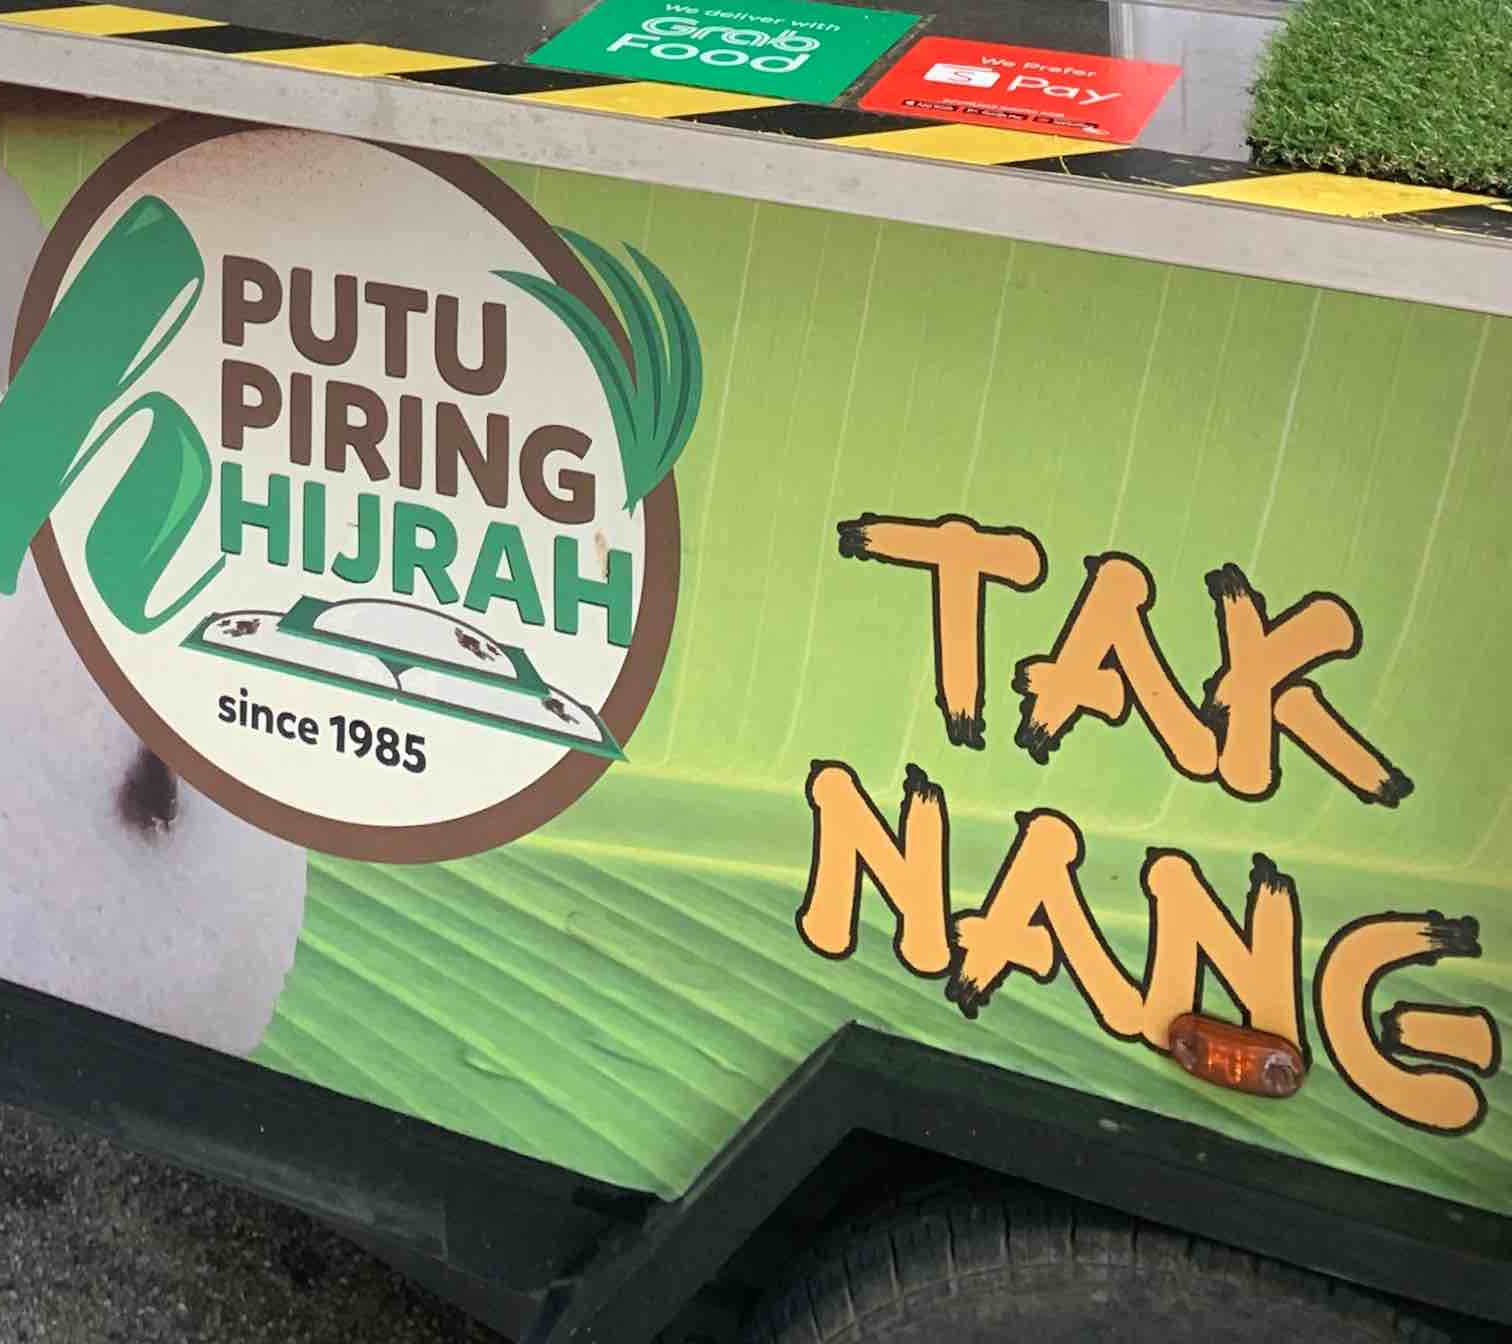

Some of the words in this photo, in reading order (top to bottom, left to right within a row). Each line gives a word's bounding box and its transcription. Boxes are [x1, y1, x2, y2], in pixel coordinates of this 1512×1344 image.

[605, 32, 811, 73] Food
[641, 15, 821, 53] Grab
[665, 2, 700, 15] We
[703, 8, 786, 25] deliver
[790, 18, 841, 32] with
[980, 55, 1016, 69] We
[1023, 60, 1096, 78] Prefer
[1006, 74, 1123, 105] Pay
[221, 254, 508, 396] PUTU
[221, 358, 597, 526] PIRING
[219, 461, 634, 648] HIJRAH
[836, 512, 1415, 808] TAK
[218, 687, 320, 746] since
[329, 715, 427, 774] 1985
[796, 759, 1503, 1137] NANG
